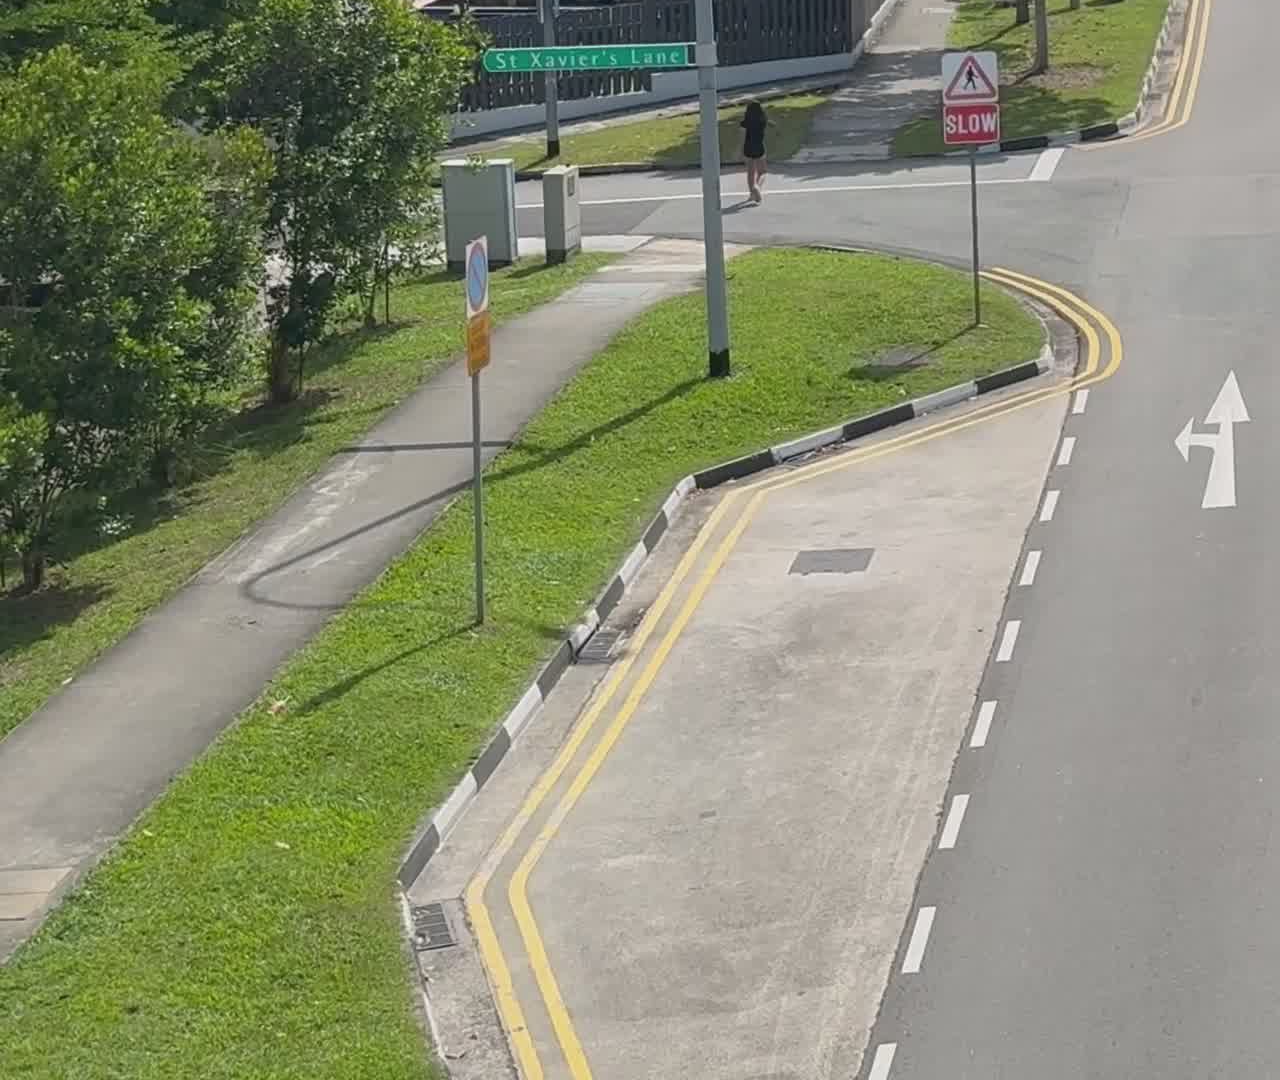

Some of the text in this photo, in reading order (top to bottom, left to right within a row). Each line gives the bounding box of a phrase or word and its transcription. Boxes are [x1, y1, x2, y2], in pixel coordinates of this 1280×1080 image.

[495, 48, 680, 69] St Xavier's Lane
[945, 113, 996, 134] SLOW
